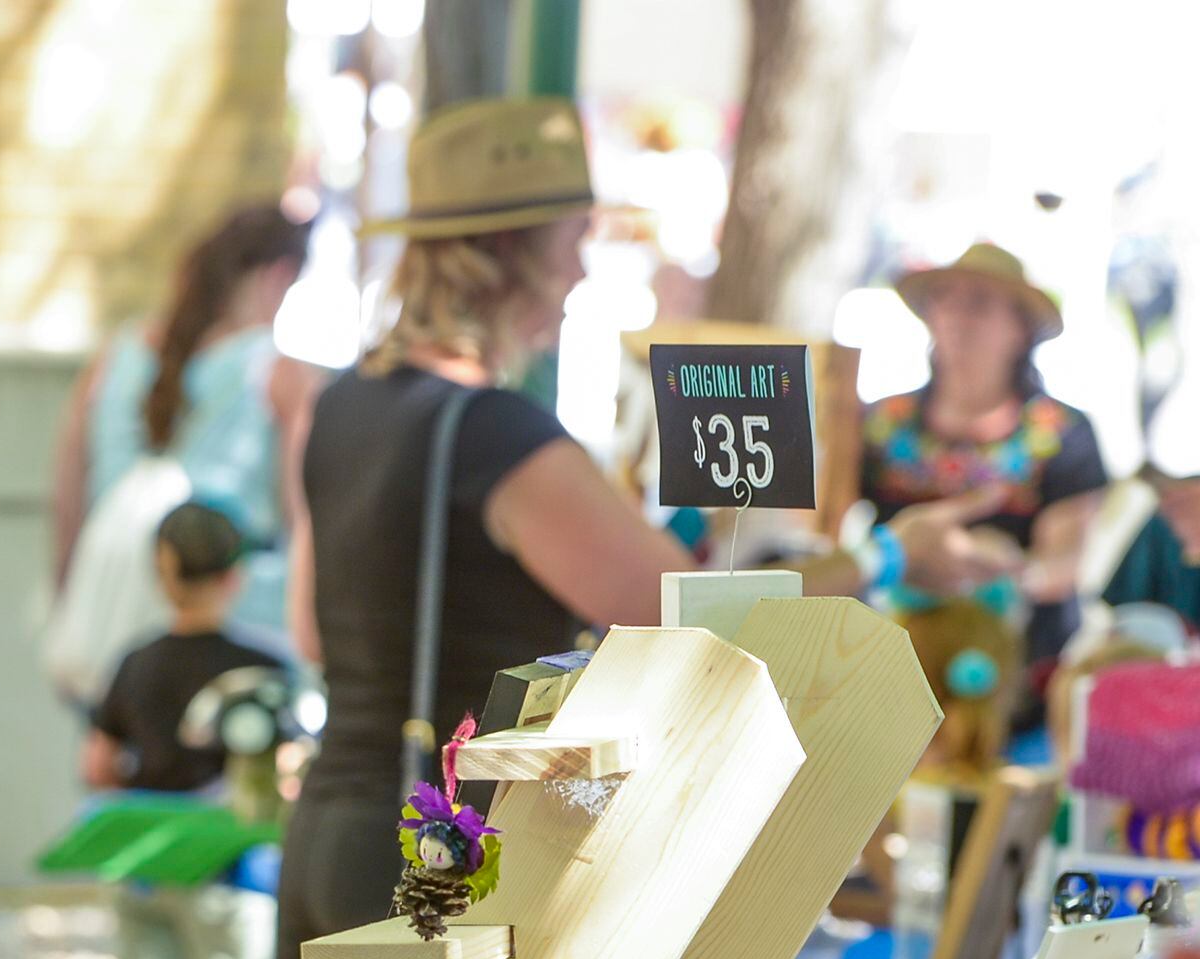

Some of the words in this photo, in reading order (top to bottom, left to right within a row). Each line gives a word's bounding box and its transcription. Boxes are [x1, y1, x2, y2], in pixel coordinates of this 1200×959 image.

[680, 364, 746, 398] ORIGINAL
[751, 364, 775, 398] ART
[692, 413, 774, 488] $35
